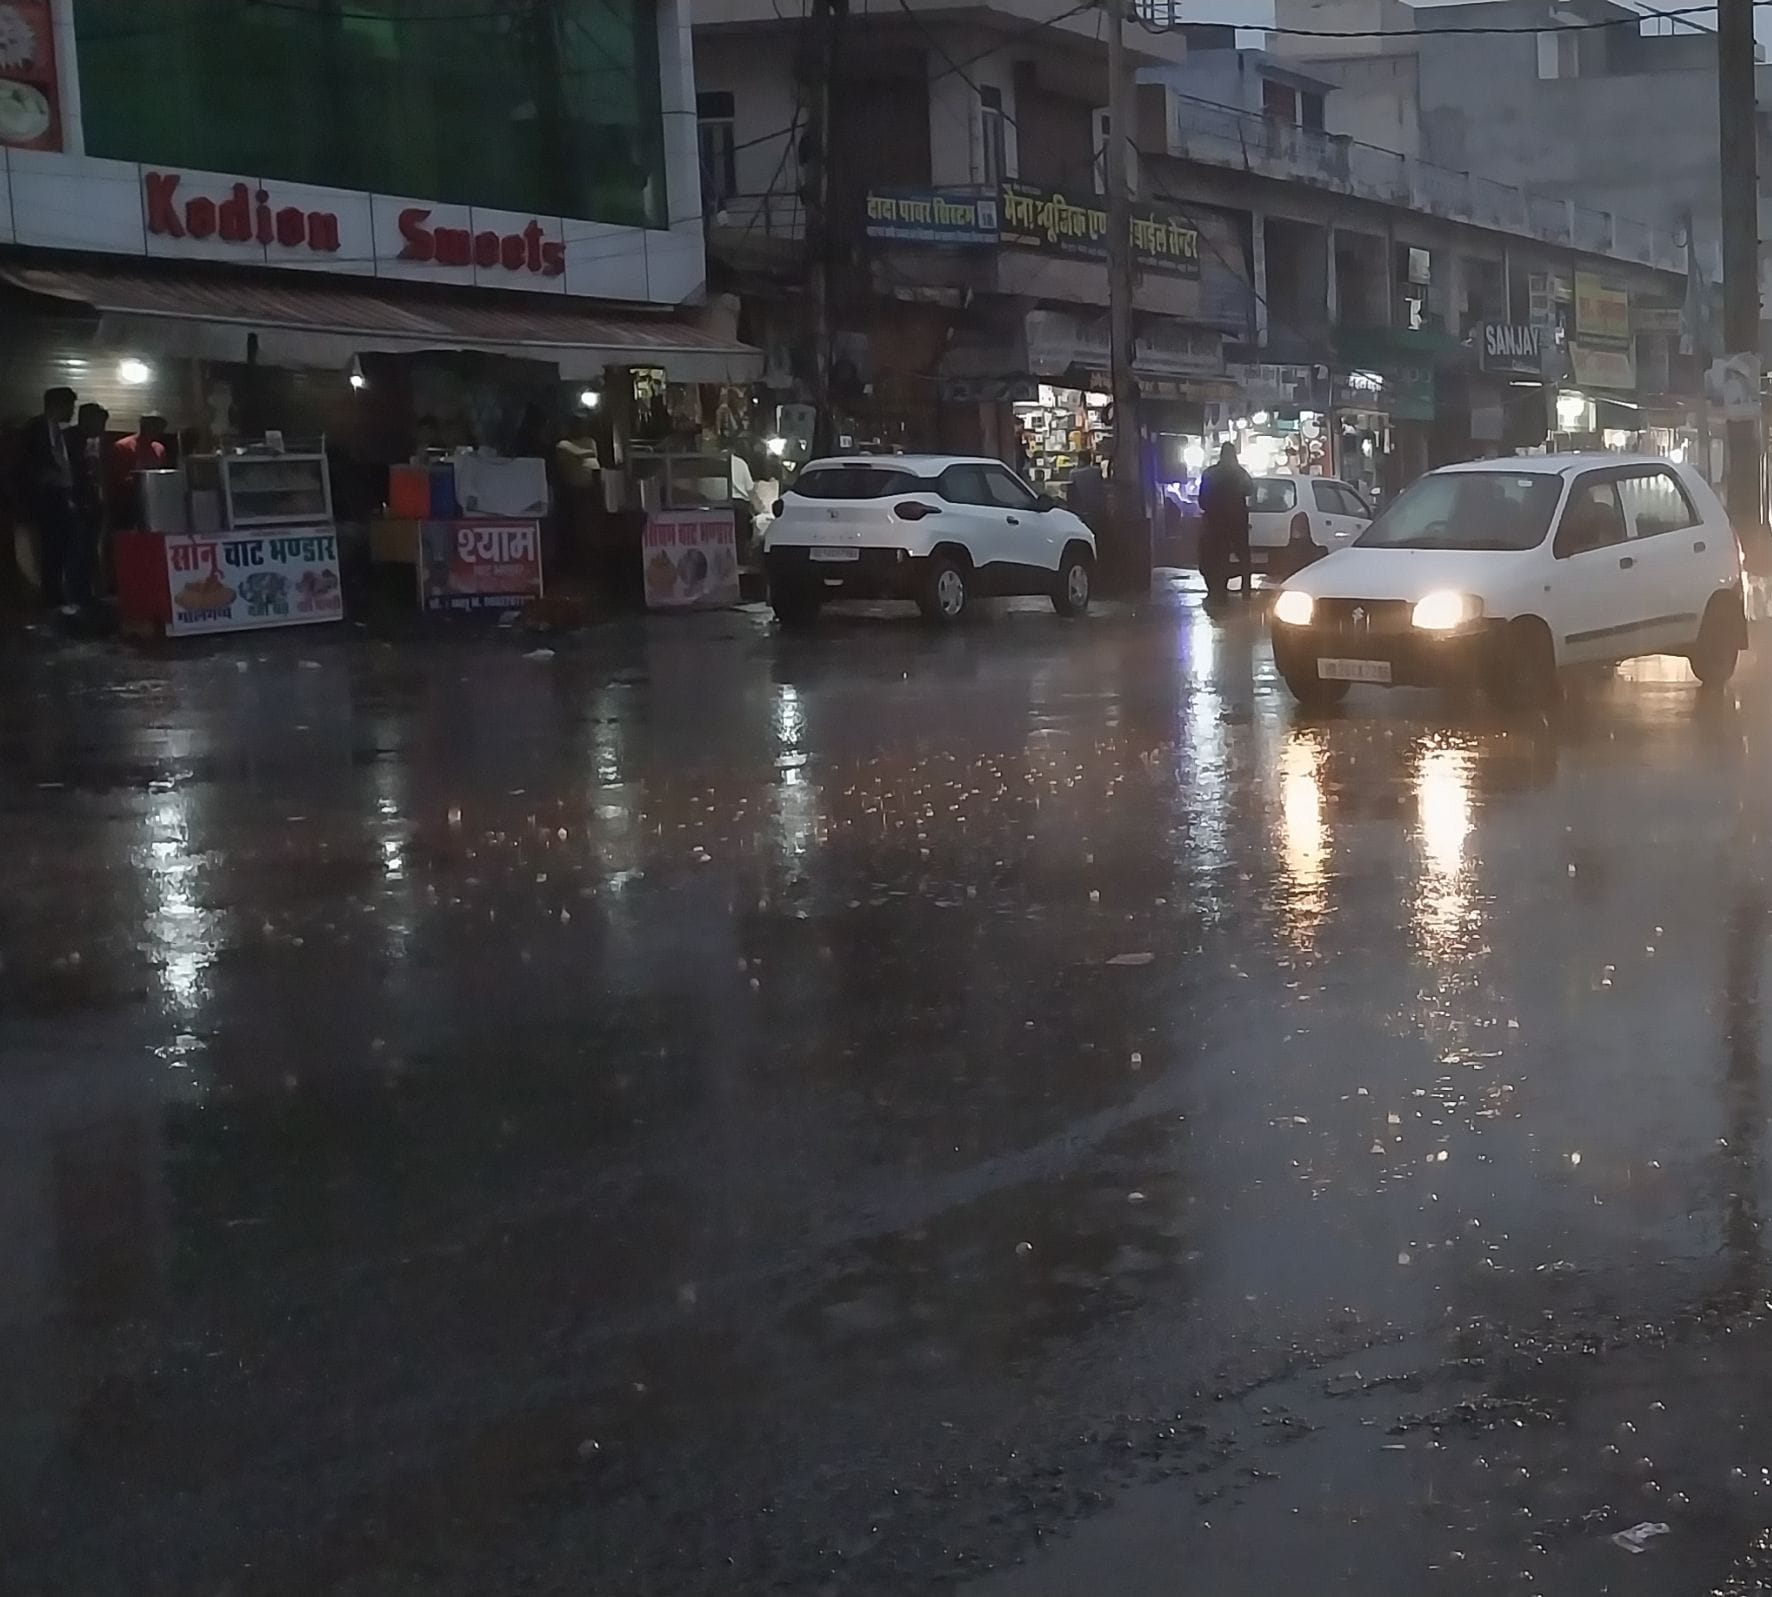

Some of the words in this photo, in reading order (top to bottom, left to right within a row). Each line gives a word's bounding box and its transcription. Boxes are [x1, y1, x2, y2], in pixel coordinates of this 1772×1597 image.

[396, 208, 566, 276] Sweets
[1485, 324, 1539, 356] SANJAY
[222, 540, 264, 568] चाट
[269, 536, 336, 564] भण्डार
[457, 526, 536, 564] श्याम
